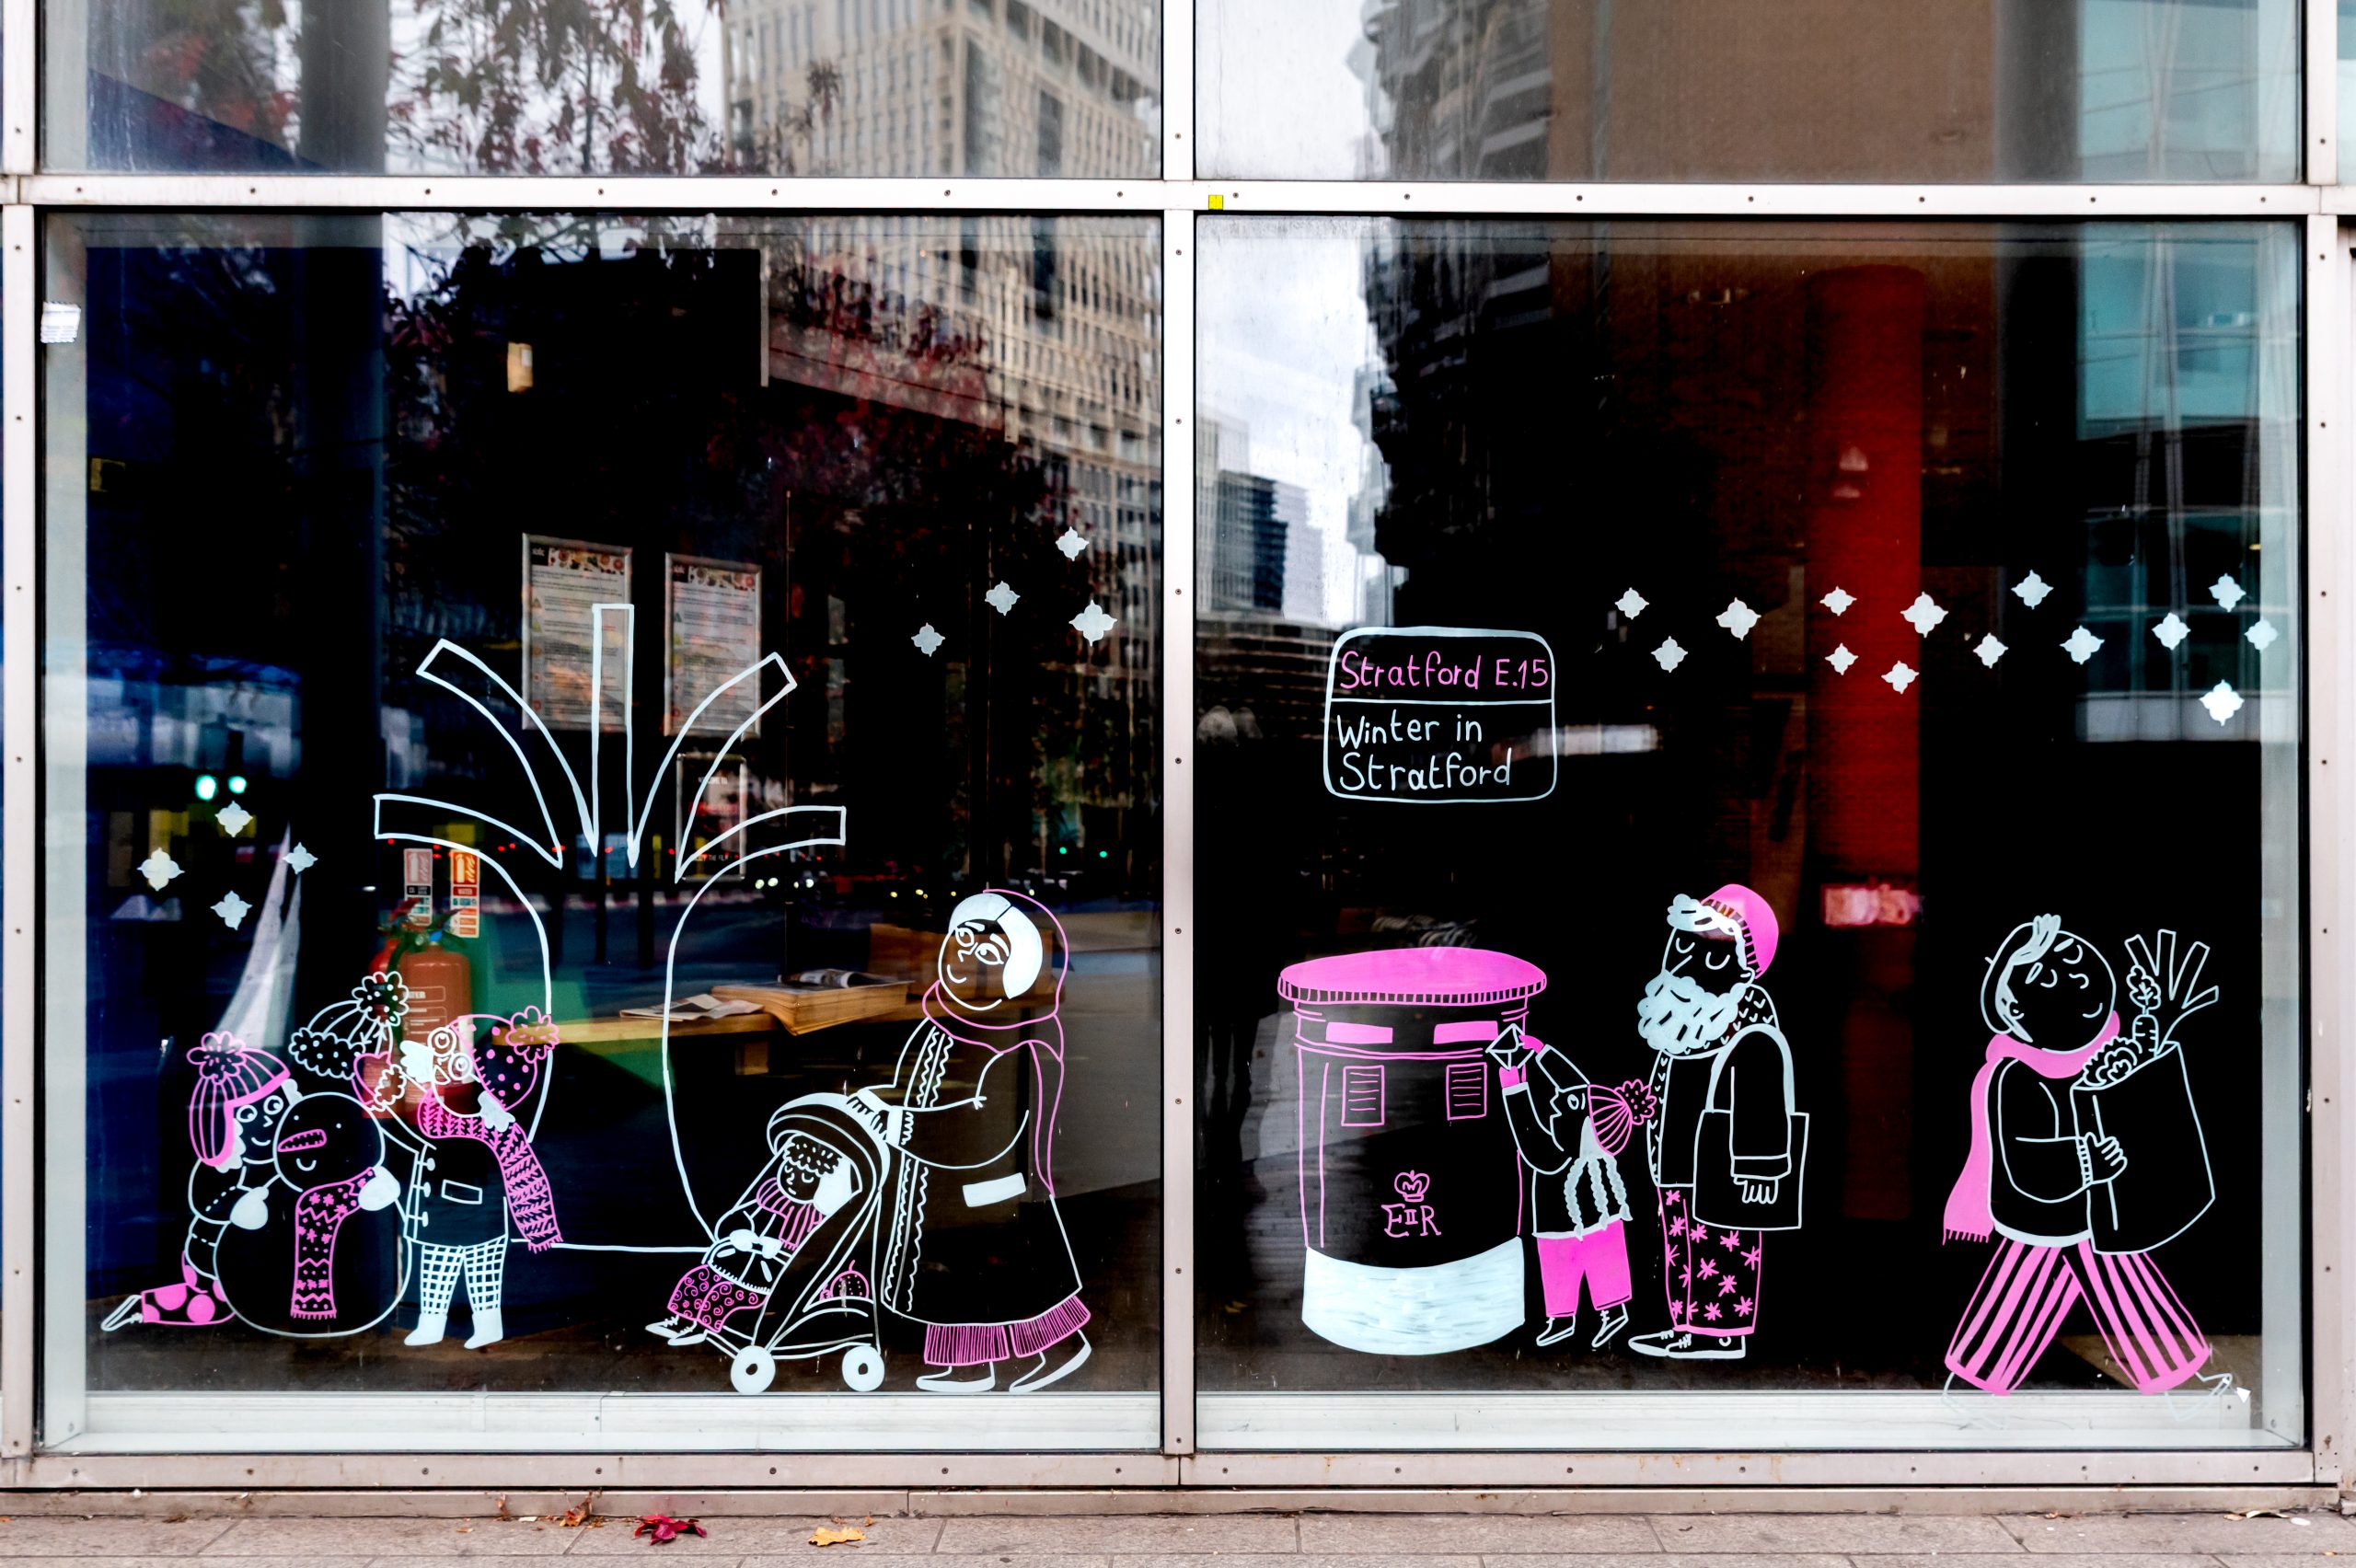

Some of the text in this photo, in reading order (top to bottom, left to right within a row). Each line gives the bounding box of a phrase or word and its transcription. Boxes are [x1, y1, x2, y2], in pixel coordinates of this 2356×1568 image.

[1340, 651, 1549, 689] Stratford E.15
[1337, 709, 1482, 749] Winter in
[1339, 748, 1512, 791] Stratford
